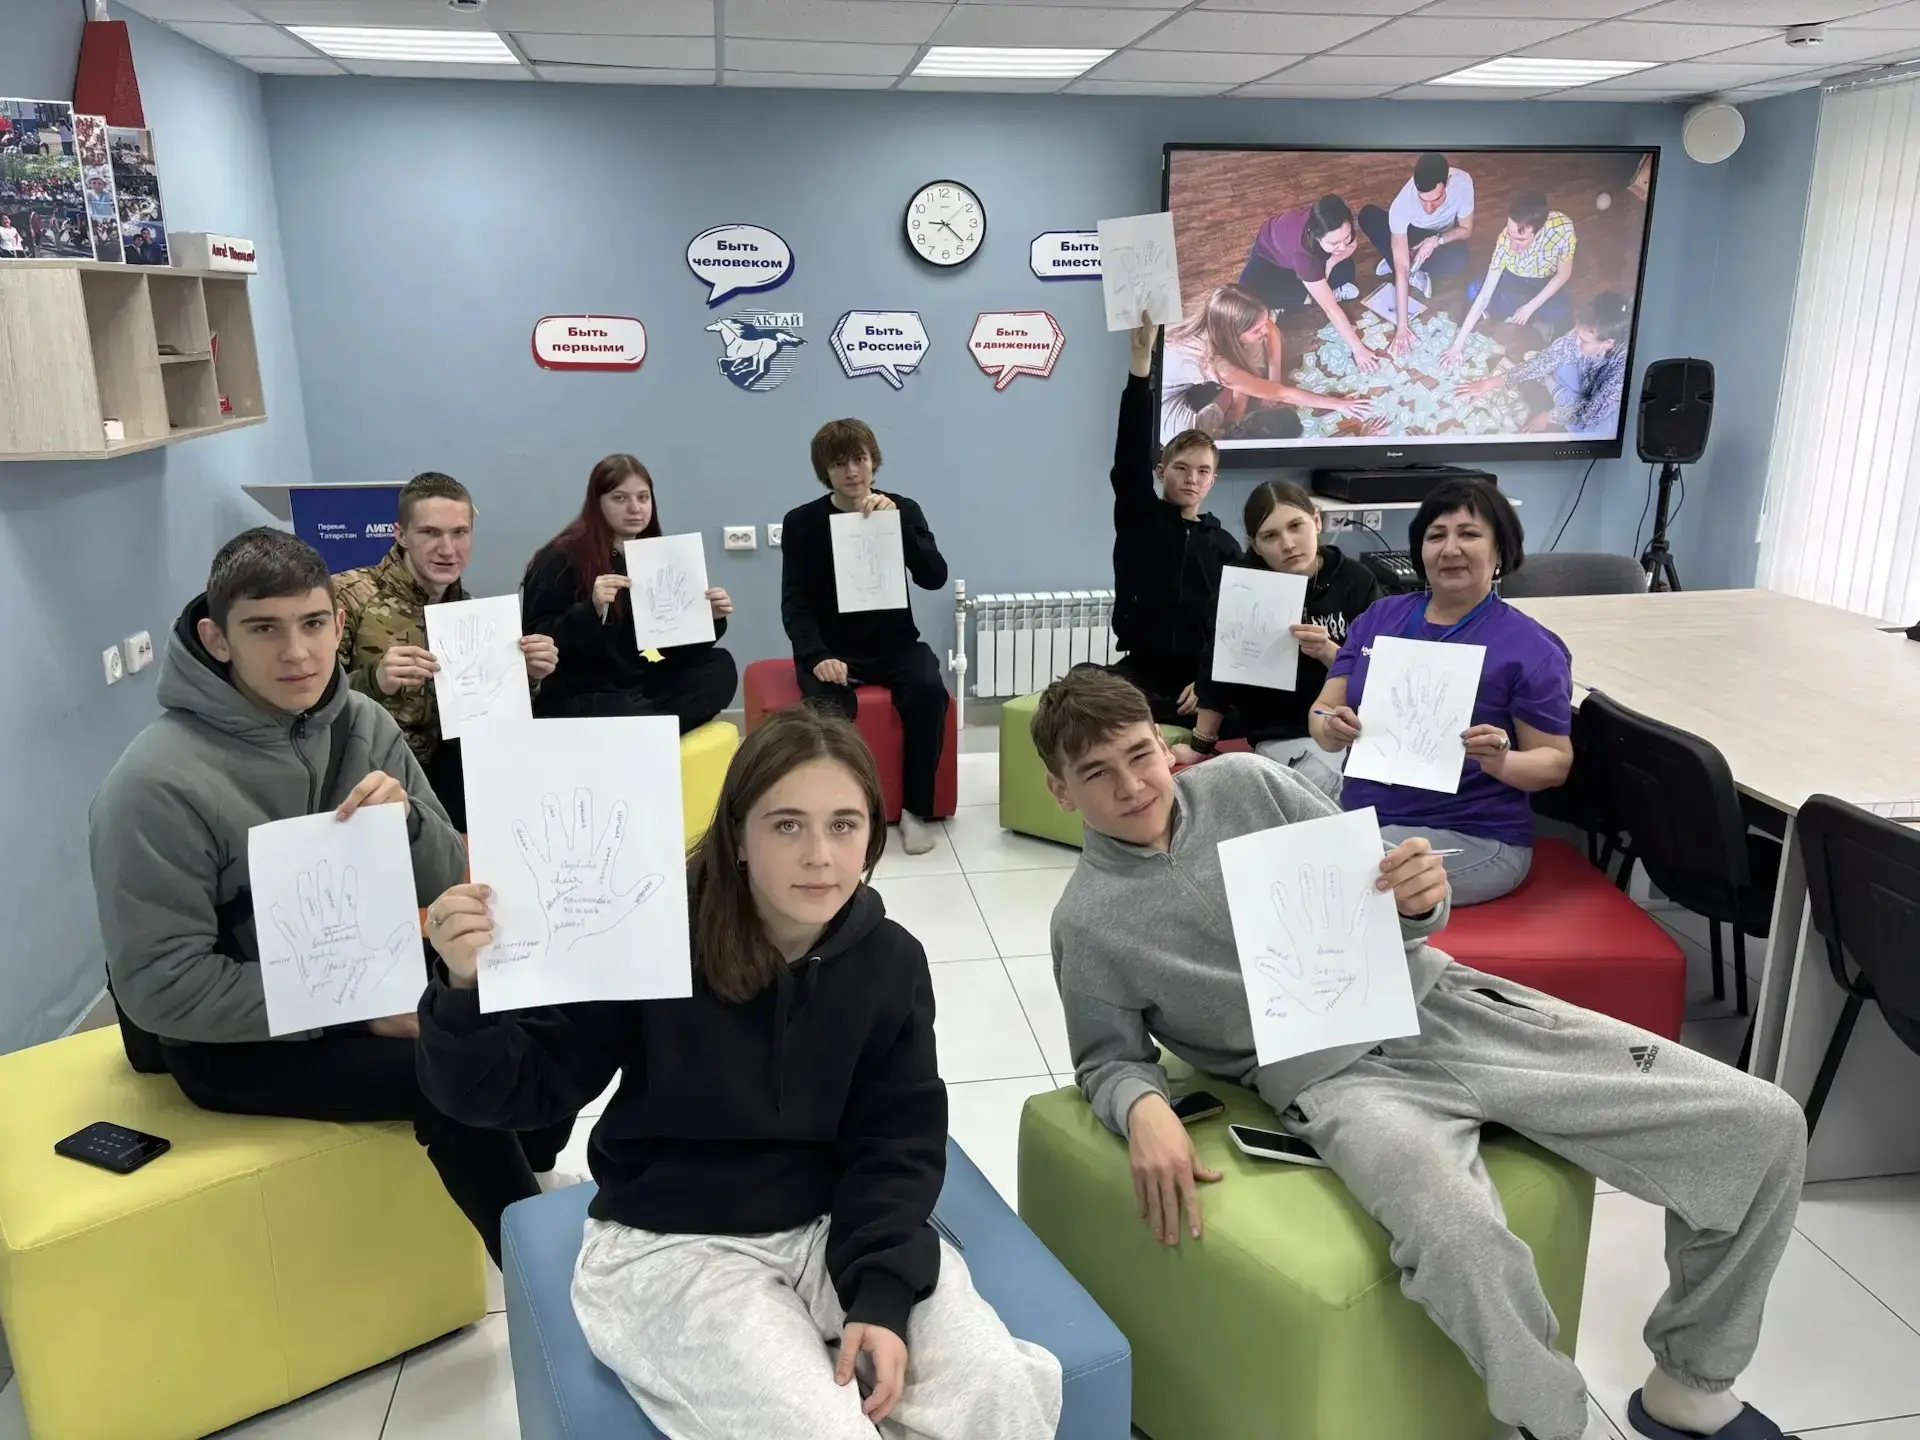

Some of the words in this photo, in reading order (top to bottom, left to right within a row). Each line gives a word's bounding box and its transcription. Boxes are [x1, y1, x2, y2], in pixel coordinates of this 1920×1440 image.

[927, 193, 934, 202] 11
[939, 188, 950, 198] 12
[915, 204, 926, 214] 10
[965, 203, 974, 213] 2
[912, 220, 921, 230] 9
[969, 218, 978, 228] 3
[917, 234, 926, 245] 8
[966, 233, 974, 243] 4
[717, 240, 759, 251] Быть
[956, 245, 965, 255] 5
[1060, 241, 1099, 252] Быть
[928, 246, 936, 256] 7
[941, 250, 950, 260] 6
[692, 258, 783, 269] человеком
[754, 313, 800, 326] АКТАЙ
[568, 327, 608, 337] Быть
[865, 326, 904, 336] Быть
[996, 328, 1028, 337] Быть
[552, 344, 624, 354] первыми
[846, 343, 855, 351] с
[859, 341, 922, 351] Россией
[983, 341, 1050, 351] движении
[319, 532, 358, 541] Татарстан
[1641, 1045, 1660, 1074] adidas
